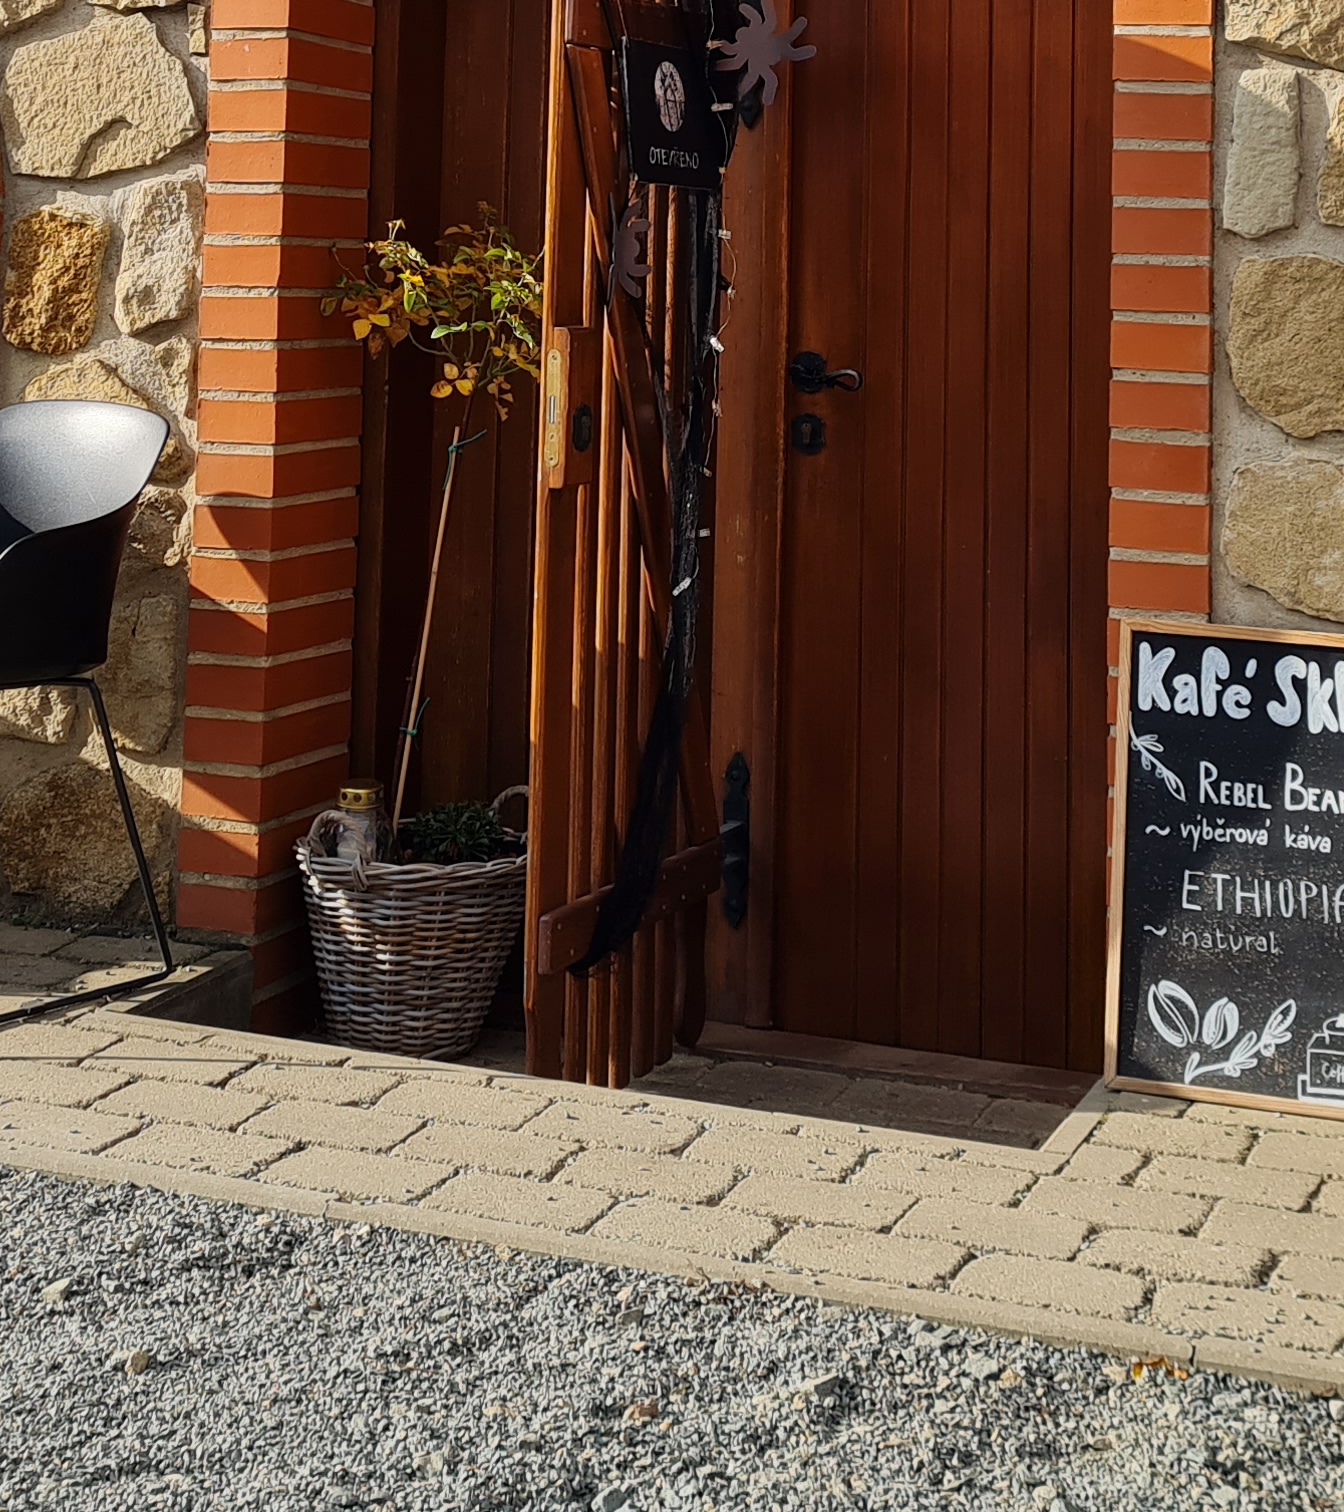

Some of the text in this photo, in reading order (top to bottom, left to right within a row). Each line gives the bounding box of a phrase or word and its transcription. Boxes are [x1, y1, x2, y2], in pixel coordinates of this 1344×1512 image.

[1137, 640, 1258, 720] Kafé
[1179, 814, 1333, 854] výběrová káva
[1180, 928, 1284, 955] natural
